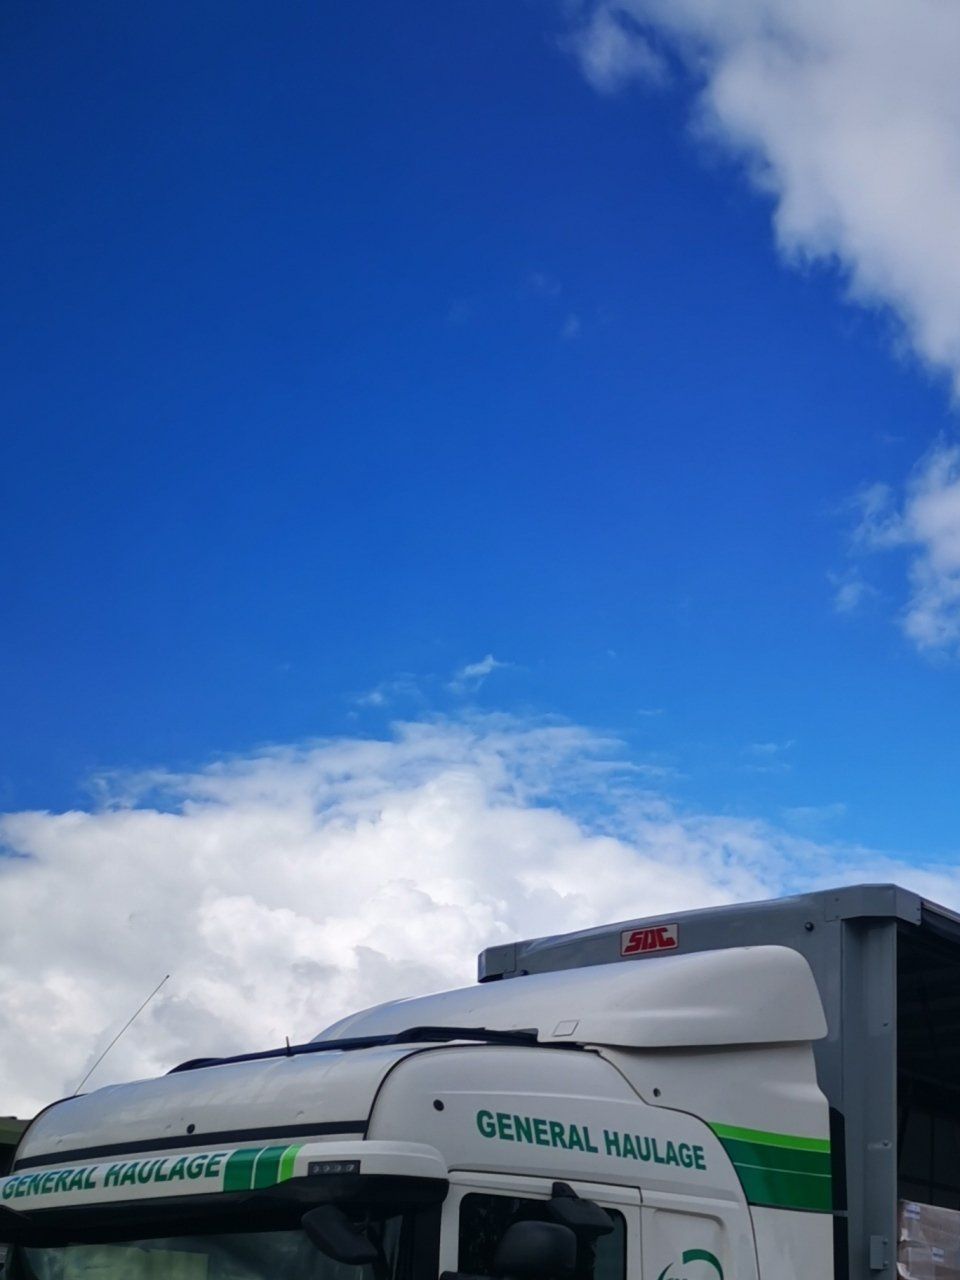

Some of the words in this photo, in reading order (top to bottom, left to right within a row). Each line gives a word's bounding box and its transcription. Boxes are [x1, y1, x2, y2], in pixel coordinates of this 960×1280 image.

[475, 1109, 598, 1154] GENERAL
[603, 1129, 707, 1171] HAULAGE
[2, 1166, 98, 1200] GENERAL
[103, 1152, 228, 1187] HAULAGE
